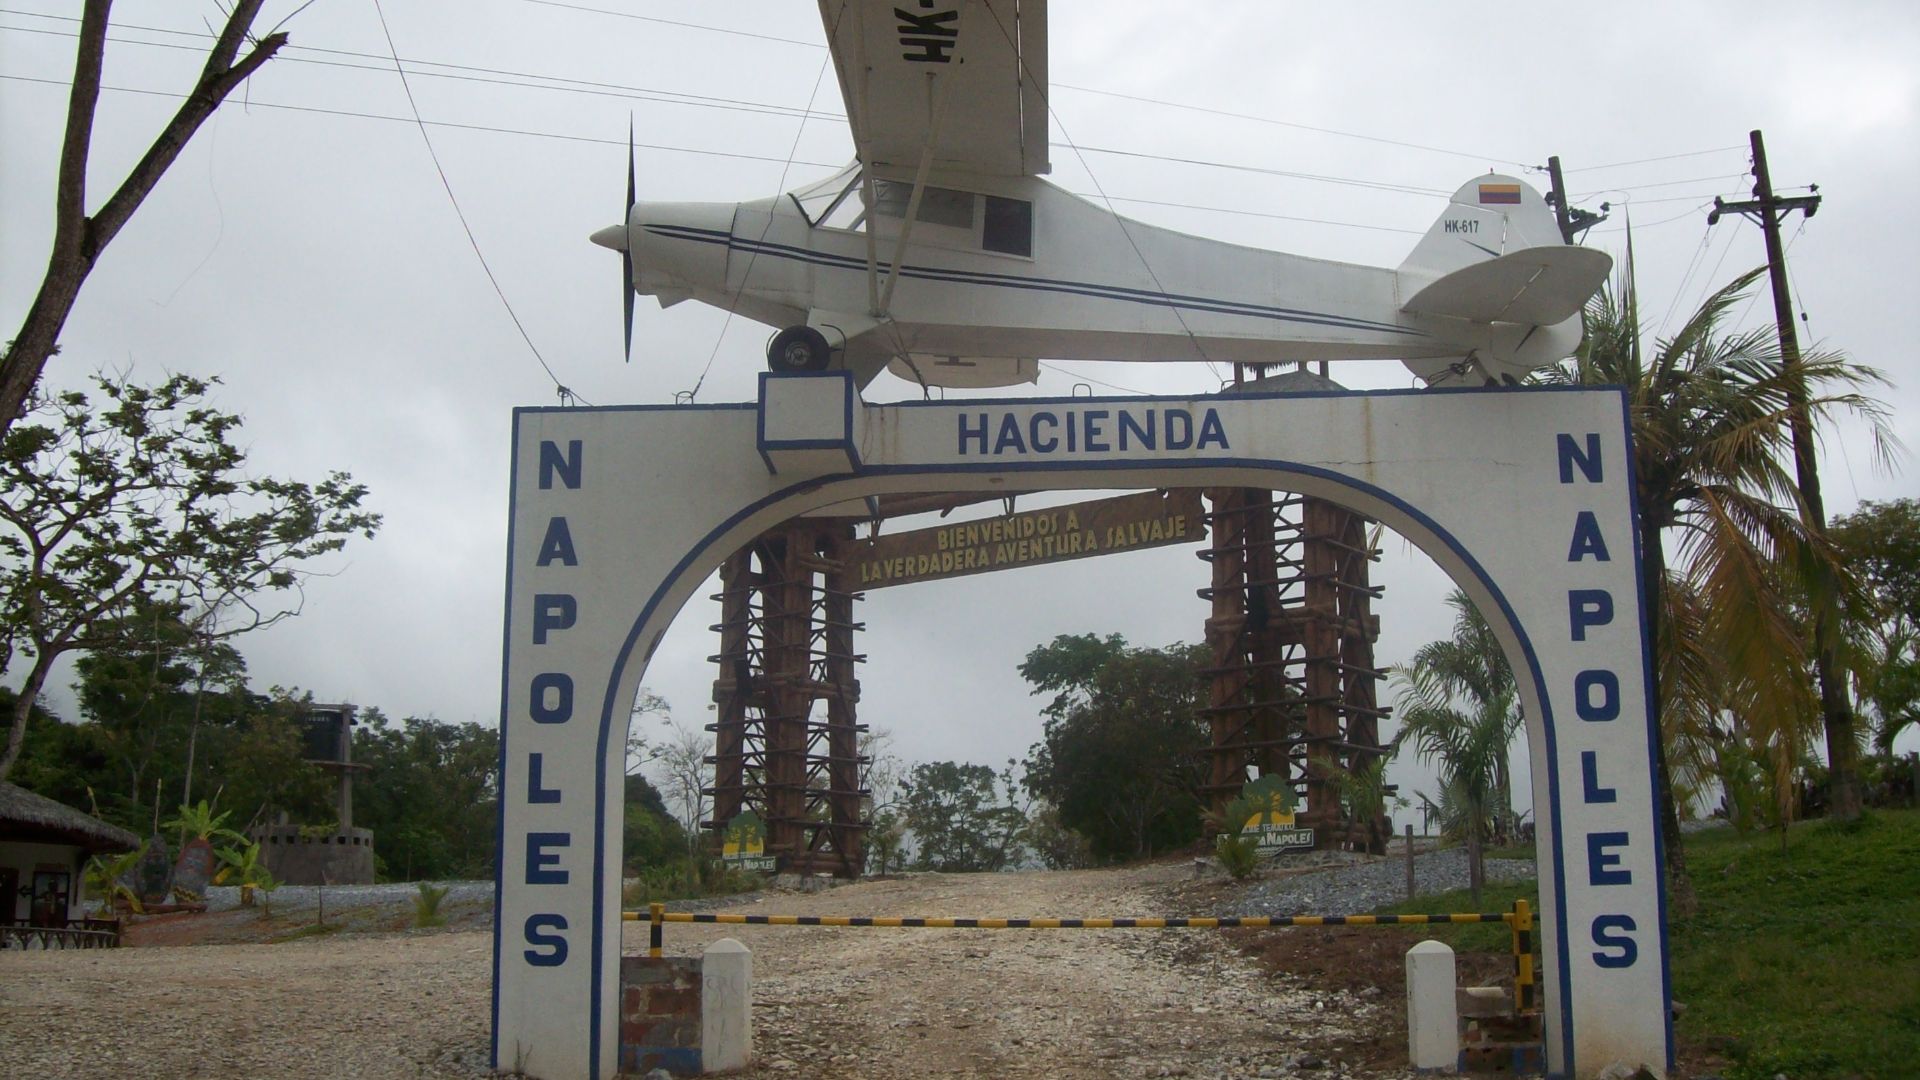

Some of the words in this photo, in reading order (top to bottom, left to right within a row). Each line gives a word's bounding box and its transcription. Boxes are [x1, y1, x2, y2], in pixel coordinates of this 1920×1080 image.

[1444, 219, 1479, 233] HK-617
[957, 408, 1231, 455] HACIENDA
[860, 561, 882, 583] LA
[883, 547, 991, 580] VERDADERA
[995, 529, 1098, 564] AVENTURA
[1104, 514, 1186, 548] SALVAJE
[936, 512, 1058, 550] BIENVENIDOS
[1065, 508, 1080, 531] A
[523, 439, 583, 967] NAPOLES
[1558, 434, 1638, 969] NAPOLES
[1266, 832, 1312, 846] NAPOLES
